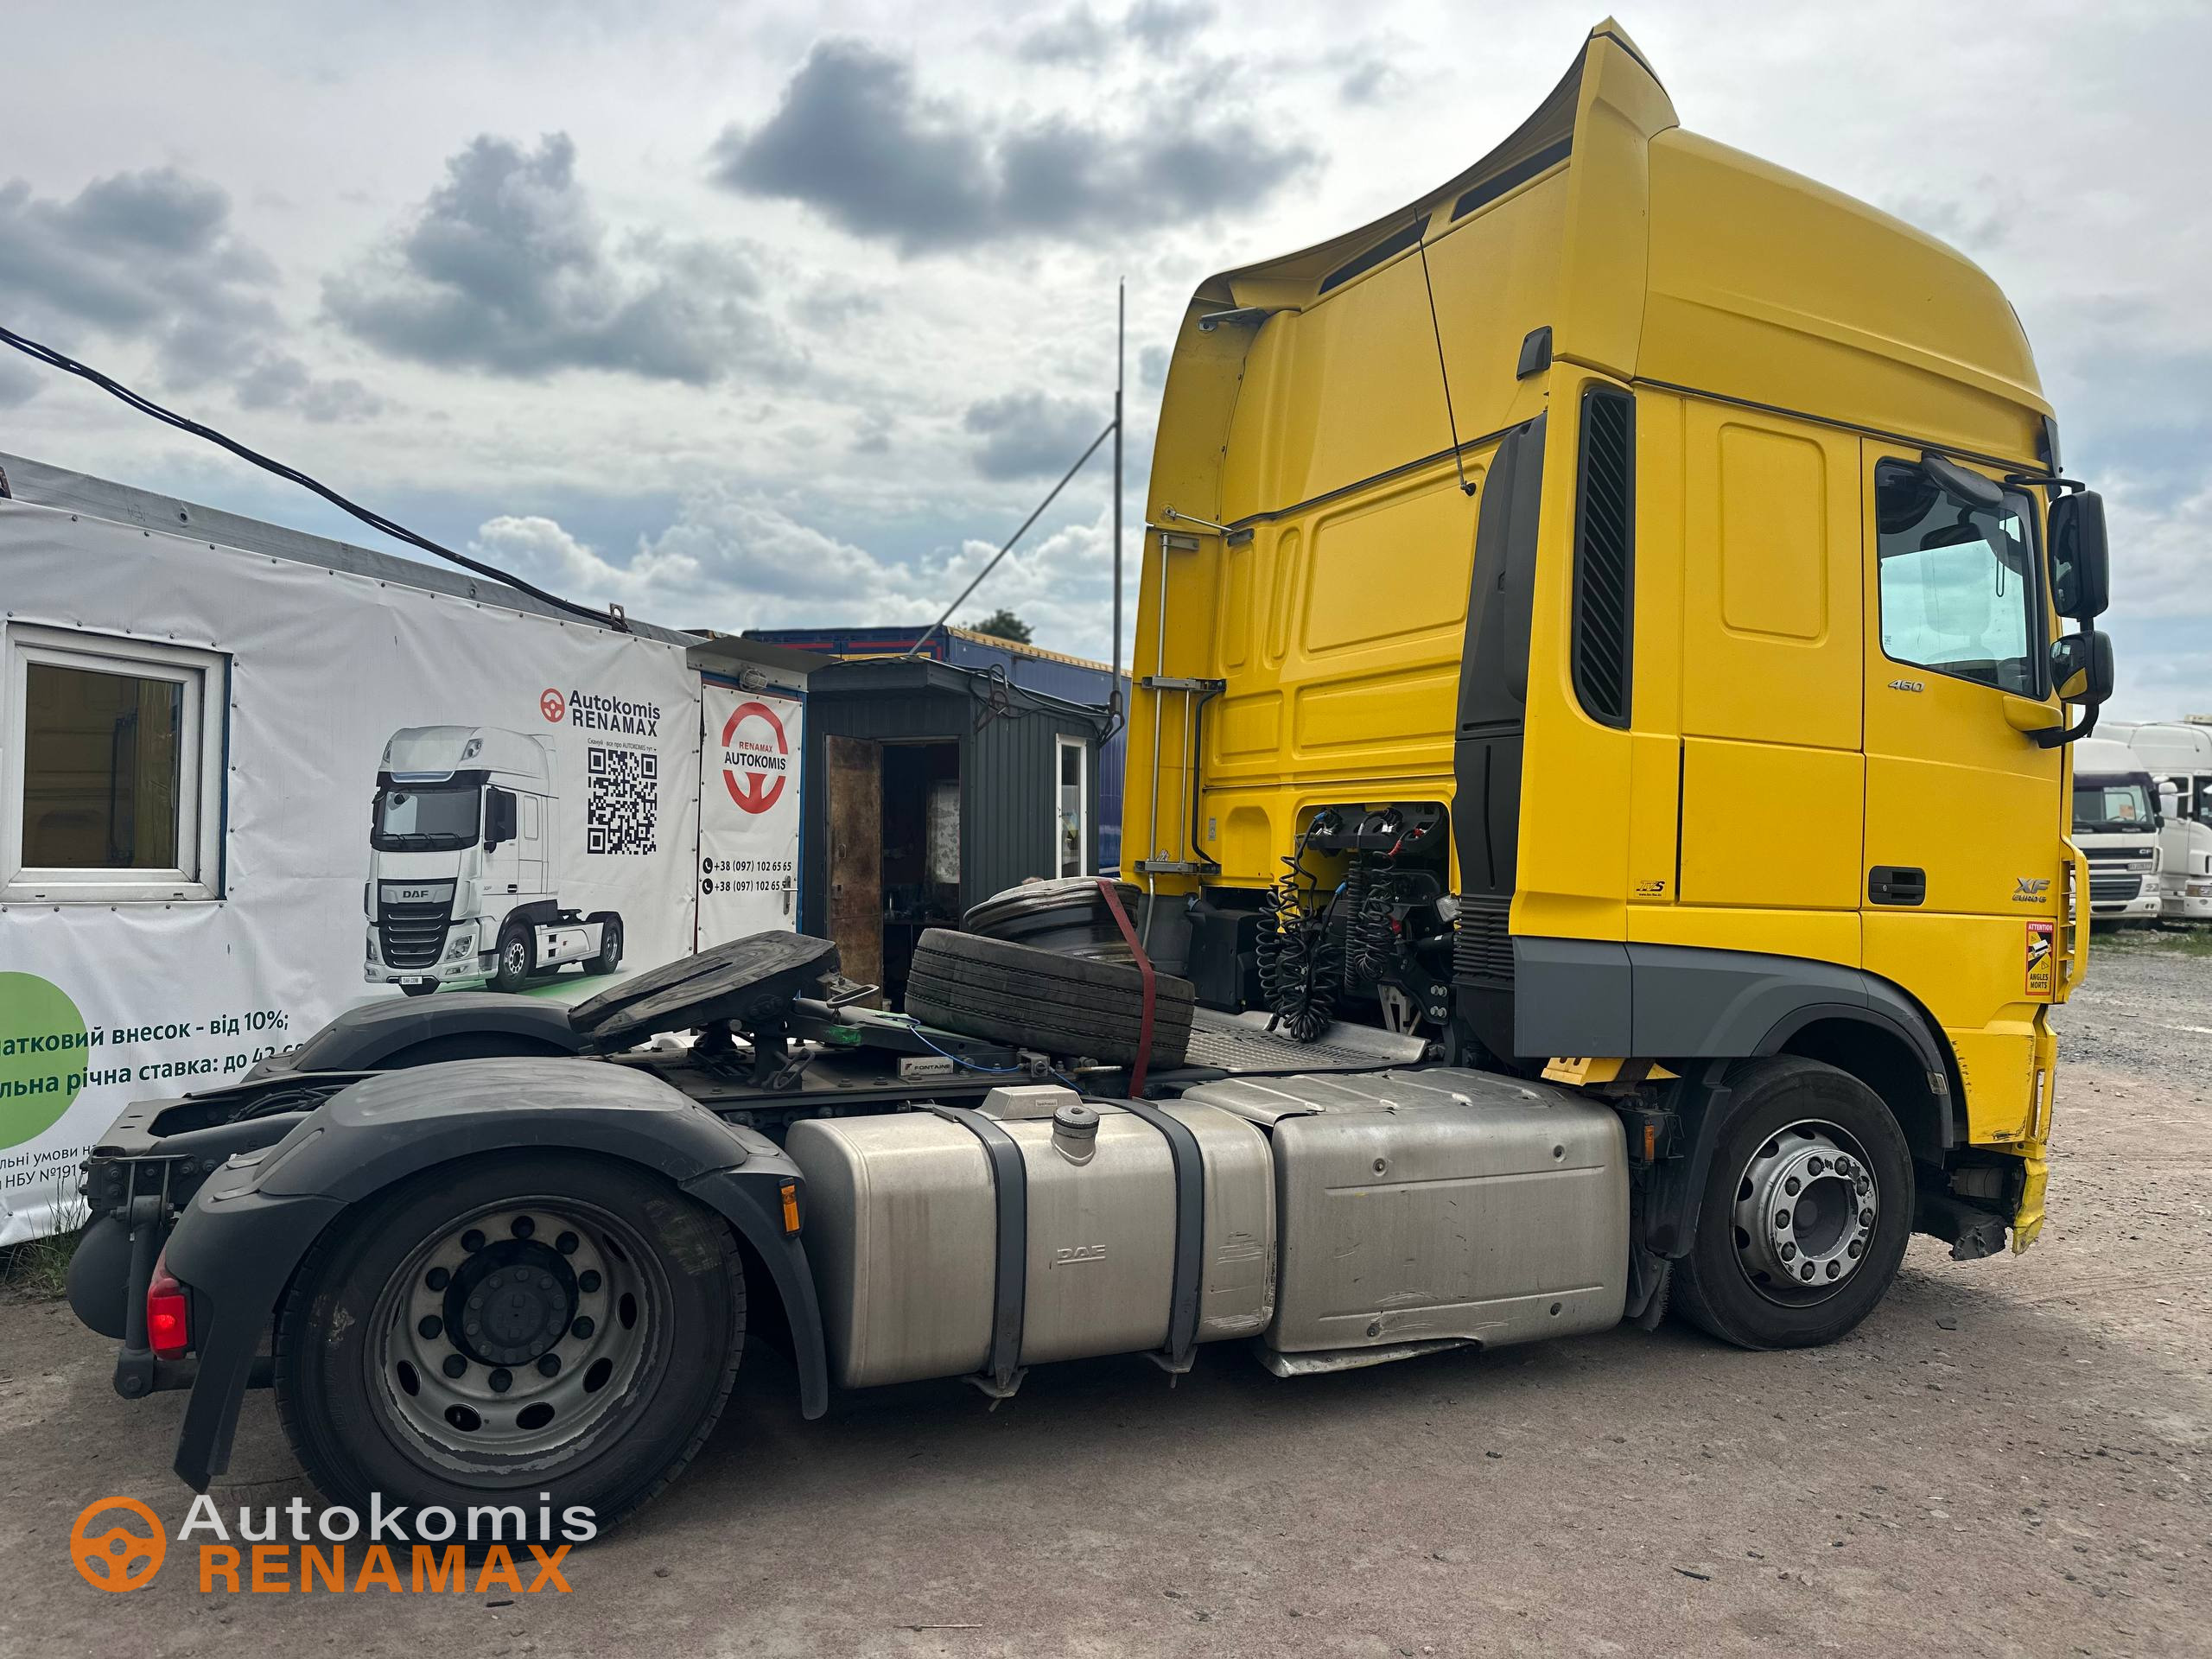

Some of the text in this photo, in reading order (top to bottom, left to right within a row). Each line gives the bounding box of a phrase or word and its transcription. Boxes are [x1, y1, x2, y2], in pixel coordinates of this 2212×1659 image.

[1888, 679, 1925, 693] 460
[569, 690, 661, 720] Autokomis
[572, 709, 658, 737] RENAMAX
[739, 741, 773, 753] RENAMAX
[724, 751, 786, 771] AUTOKOMIS
[715, 860, 791, 873] +38 (097) 102 65 65
[715, 881, 731, 892] +38
[733, 880, 753, 892] (097)
[756, 881, 769, 891] 102
[772, 881, 780, 890] 65
[2014, 878, 2050, 893] XF
[403, 890, 429, 899] DAF
[2028, 923, 2053, 931] ATTENTION
[0, 1027, 105, 1056] атковий
[112, 1022, 191, 1045] внесок
[210, 1014, 239, 1036] від
[244, 1009, 289, 1031] 10%;
[0, 1076, 59, 1098] льна
[67, 1067, 131, 1096] річна
[138, 1057, 218, 1081] ставка:
[223, 1052, 248, 1074] до
[34, 1147, 78, 1167] умови
[5, 1171, 35, 1189] НБУ
[1057, 1244, 1106, 1259] DAF
